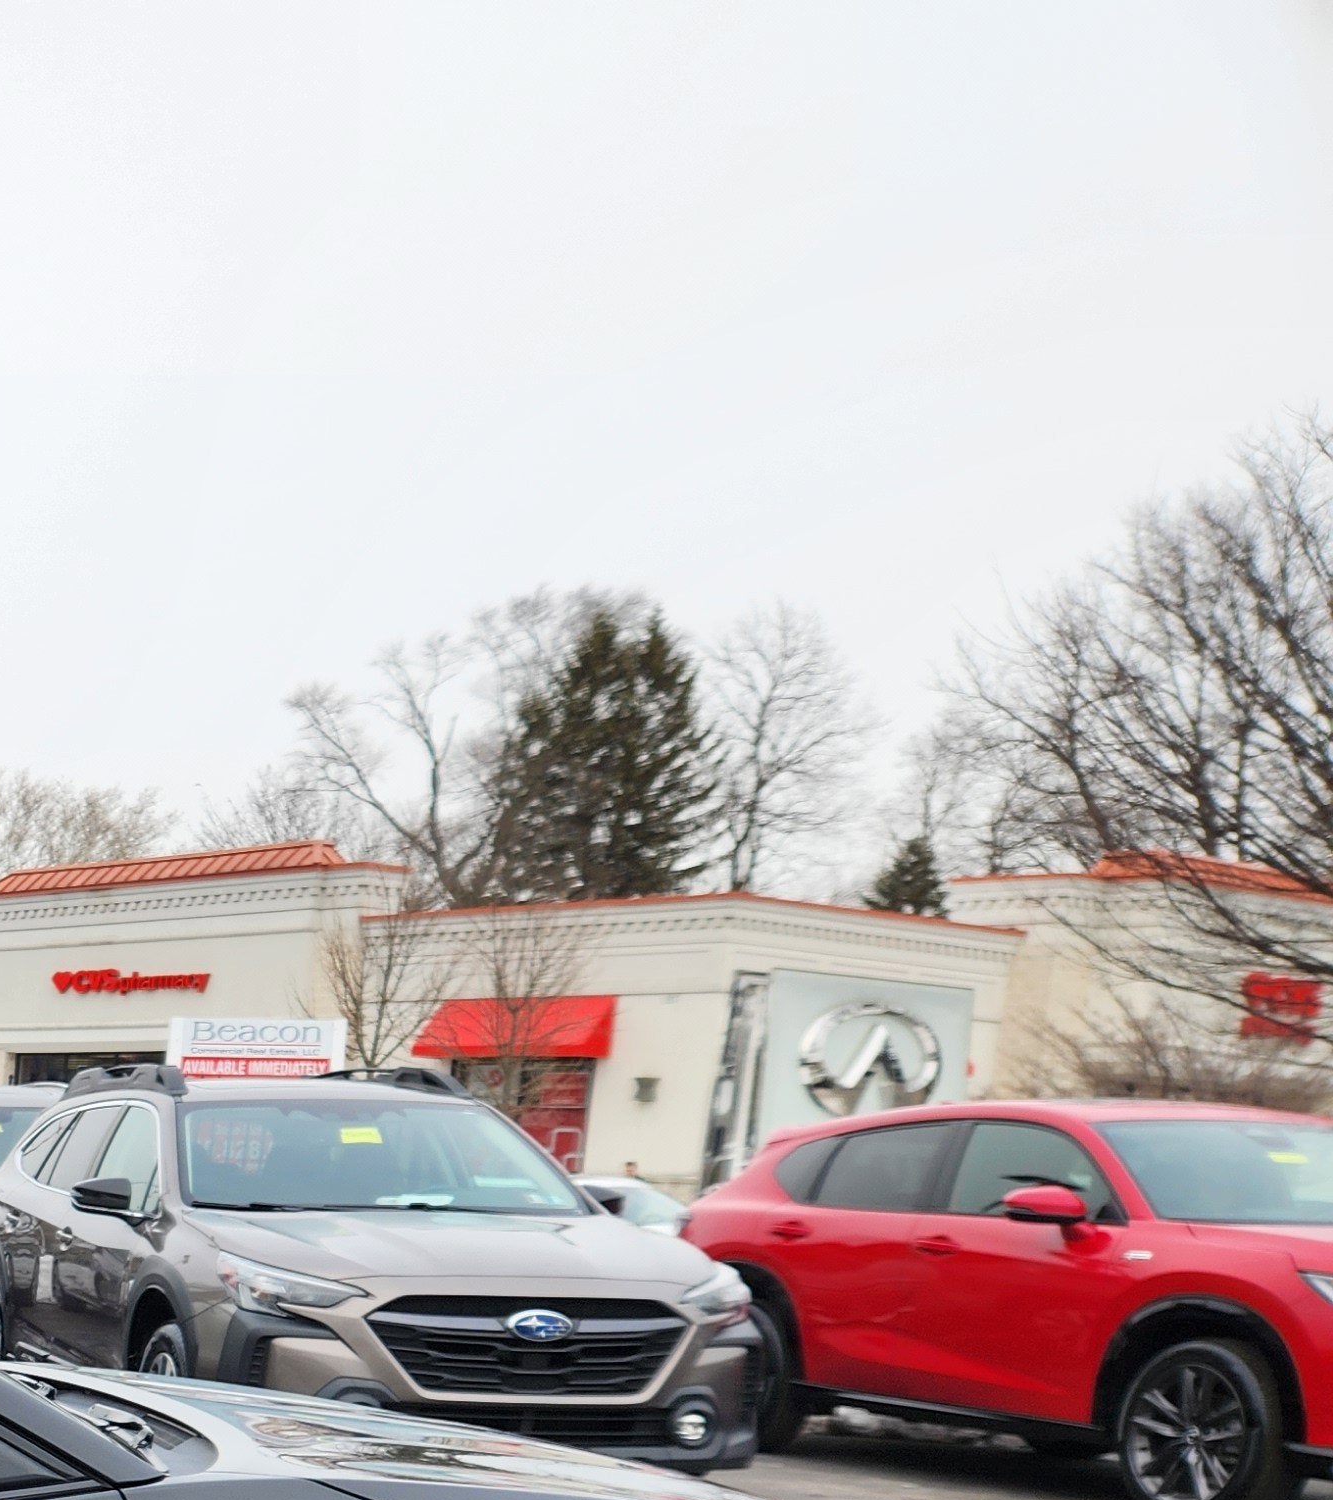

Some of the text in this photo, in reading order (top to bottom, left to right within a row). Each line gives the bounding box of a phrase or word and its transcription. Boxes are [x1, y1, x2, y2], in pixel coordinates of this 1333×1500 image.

[190, 1021, 322, 1044] Beacon
[182, 1059, 328, 1076] AVAILABLE IMMEDIATELY
